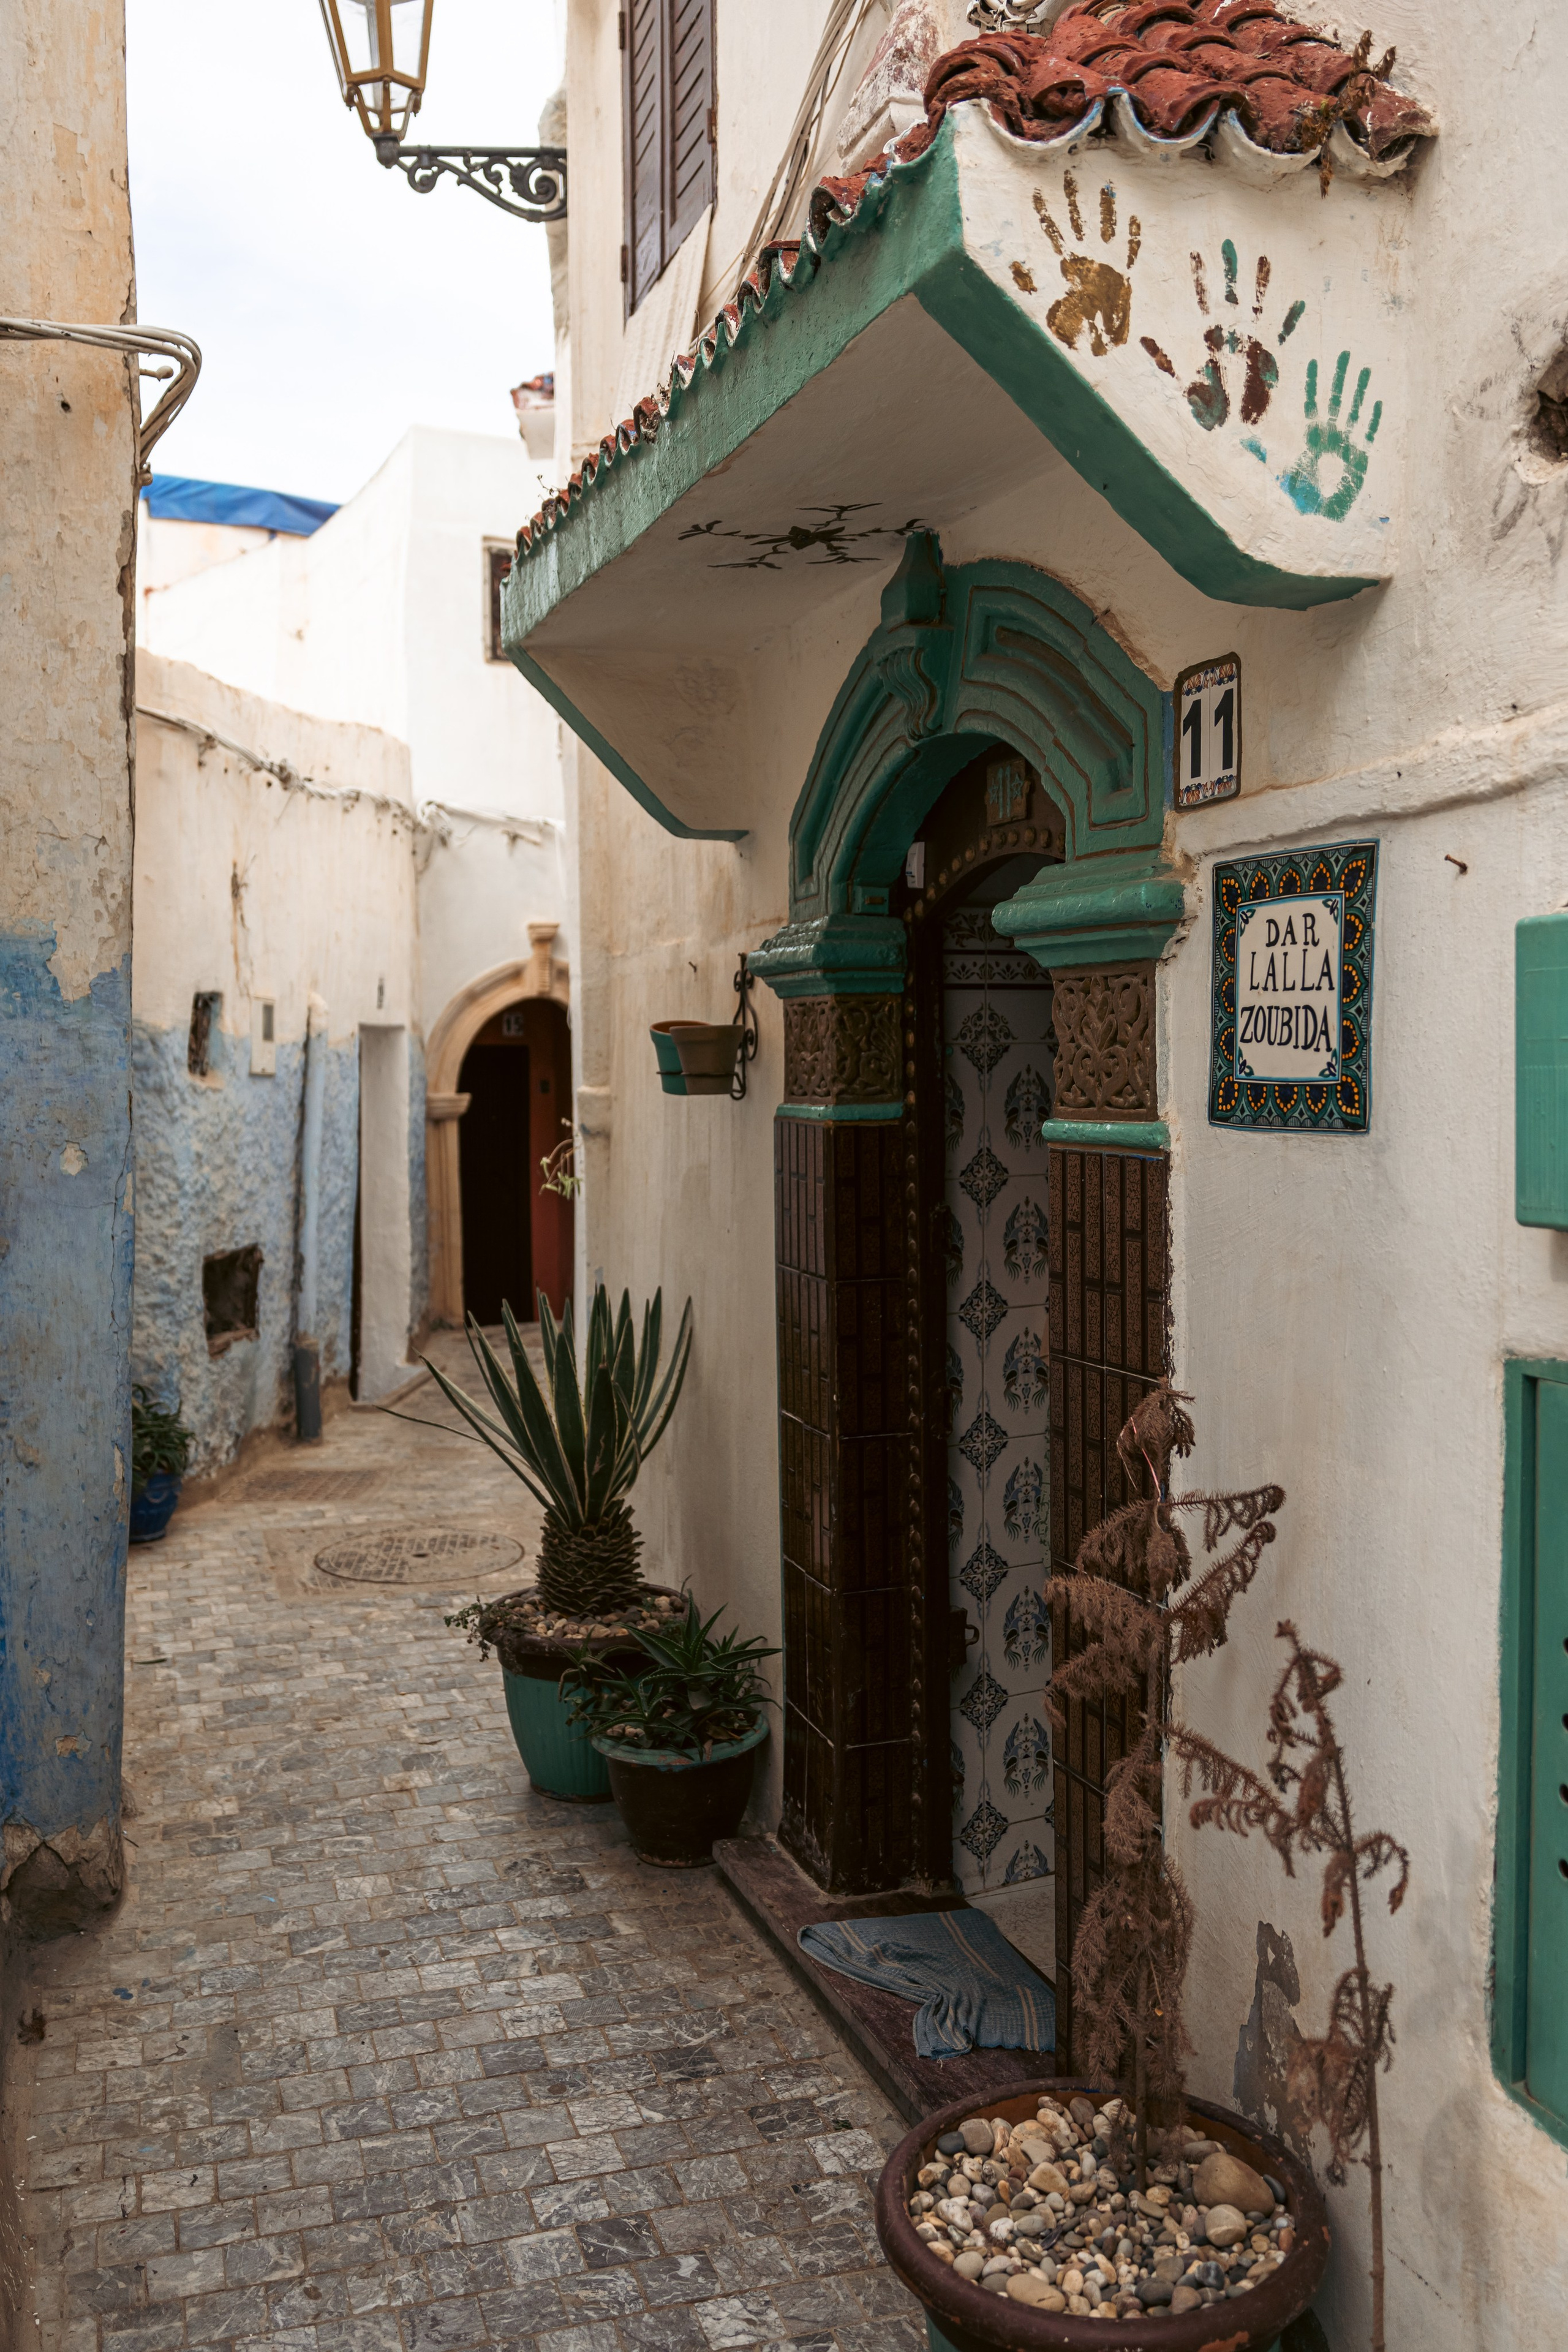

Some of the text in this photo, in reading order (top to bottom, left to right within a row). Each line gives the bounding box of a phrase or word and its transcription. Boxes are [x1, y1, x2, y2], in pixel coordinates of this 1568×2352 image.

[1182, 688, 1234, 778] 11
[1265, 913, 1319, 948] DAR
[1250, 948, 1335, 992] LALLA
[1240, 1005, 1333, 1052] ZOUBIDA
